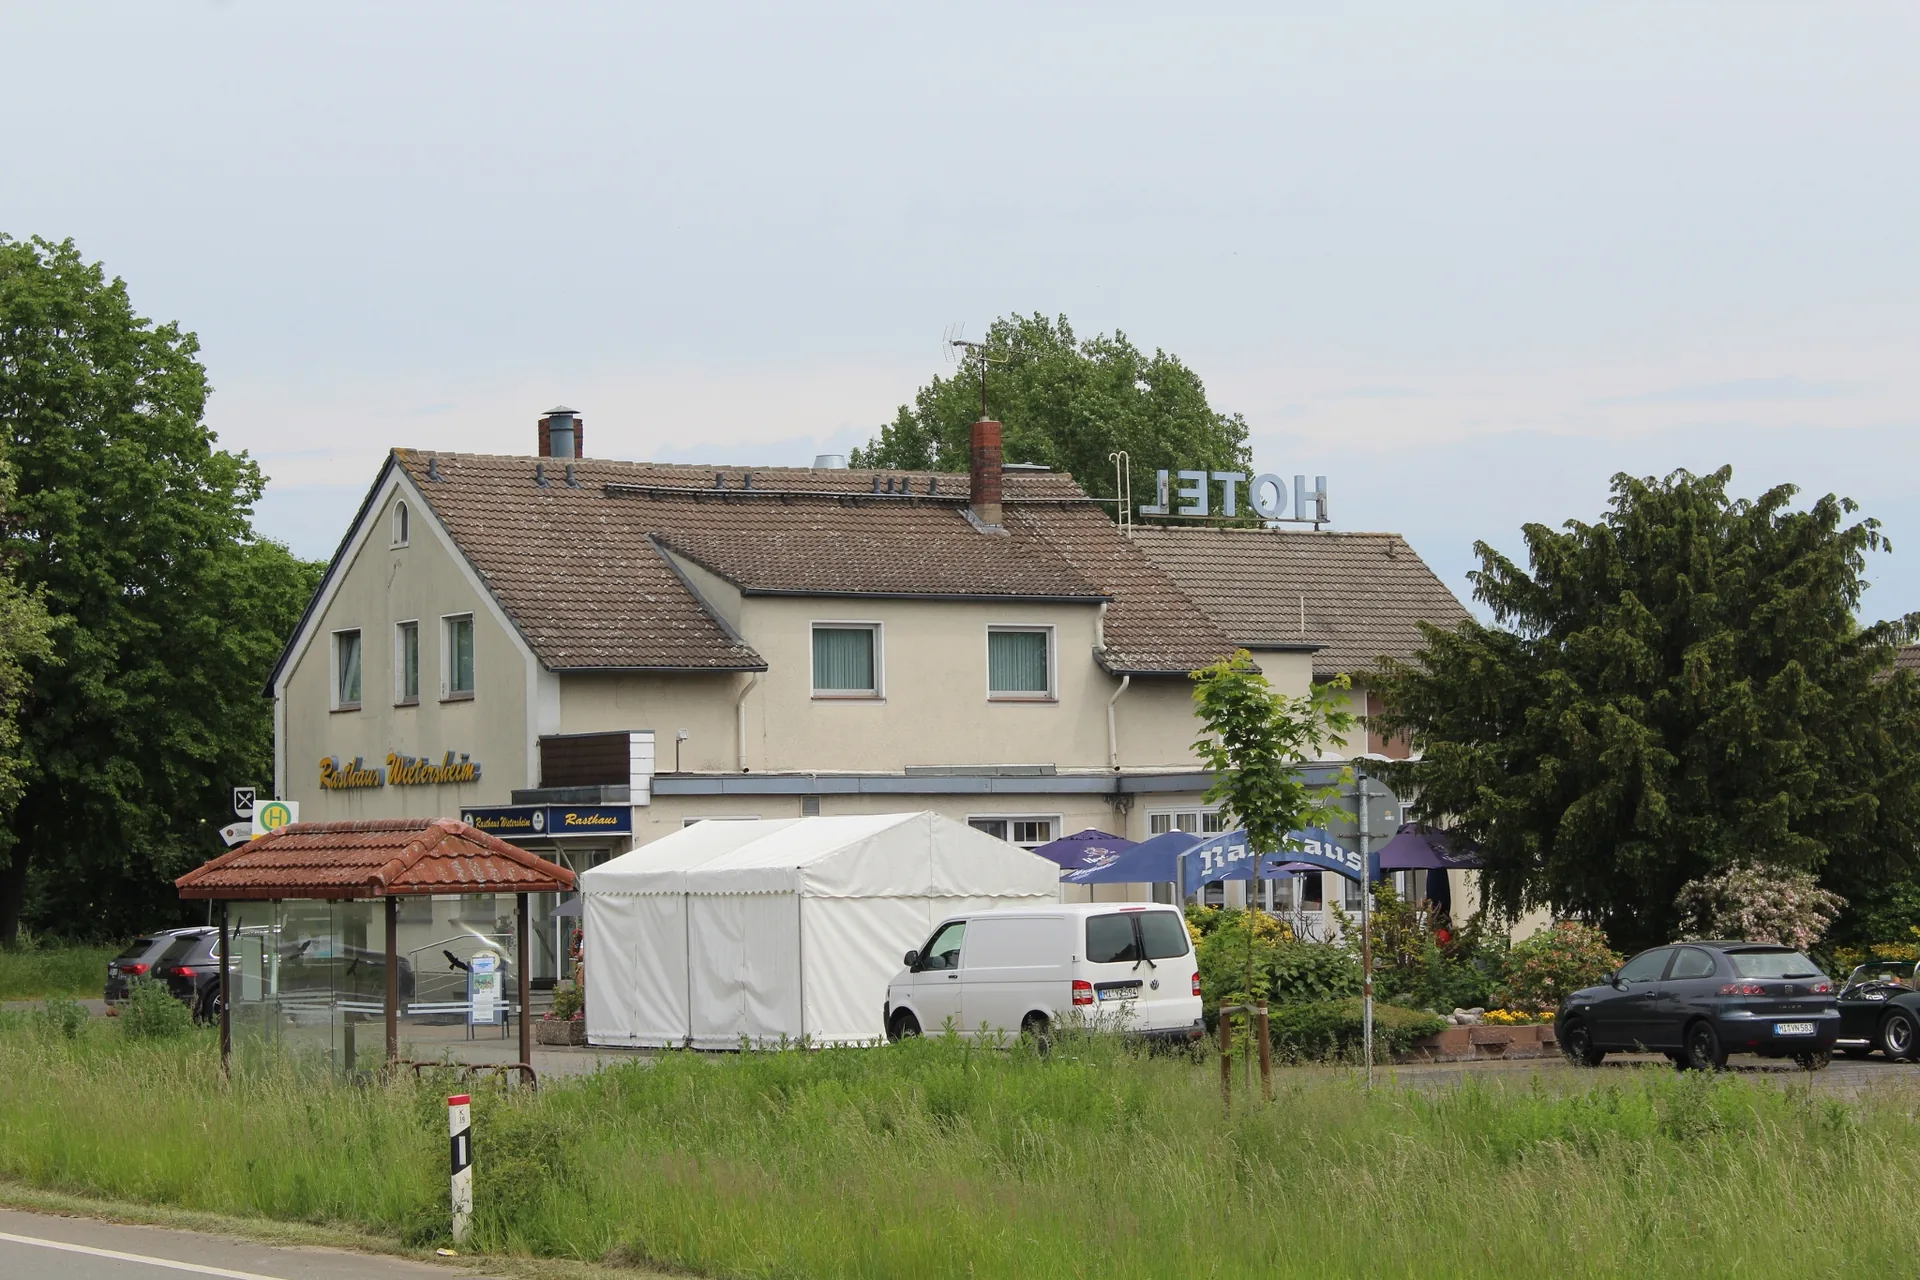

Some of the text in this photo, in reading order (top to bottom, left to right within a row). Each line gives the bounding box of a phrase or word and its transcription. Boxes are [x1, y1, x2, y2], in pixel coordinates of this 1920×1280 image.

[319, 751, 479, 789] Rasthaus Wietersheim
[269, 809, 282, 827] H
[475, 816, 500, 829] Rasthaus
[500, 816, 531, 828] Wietersheim
[564, 811, 617, 825] Rasthaus
[1200, 832, 1362, 877] Raaus
